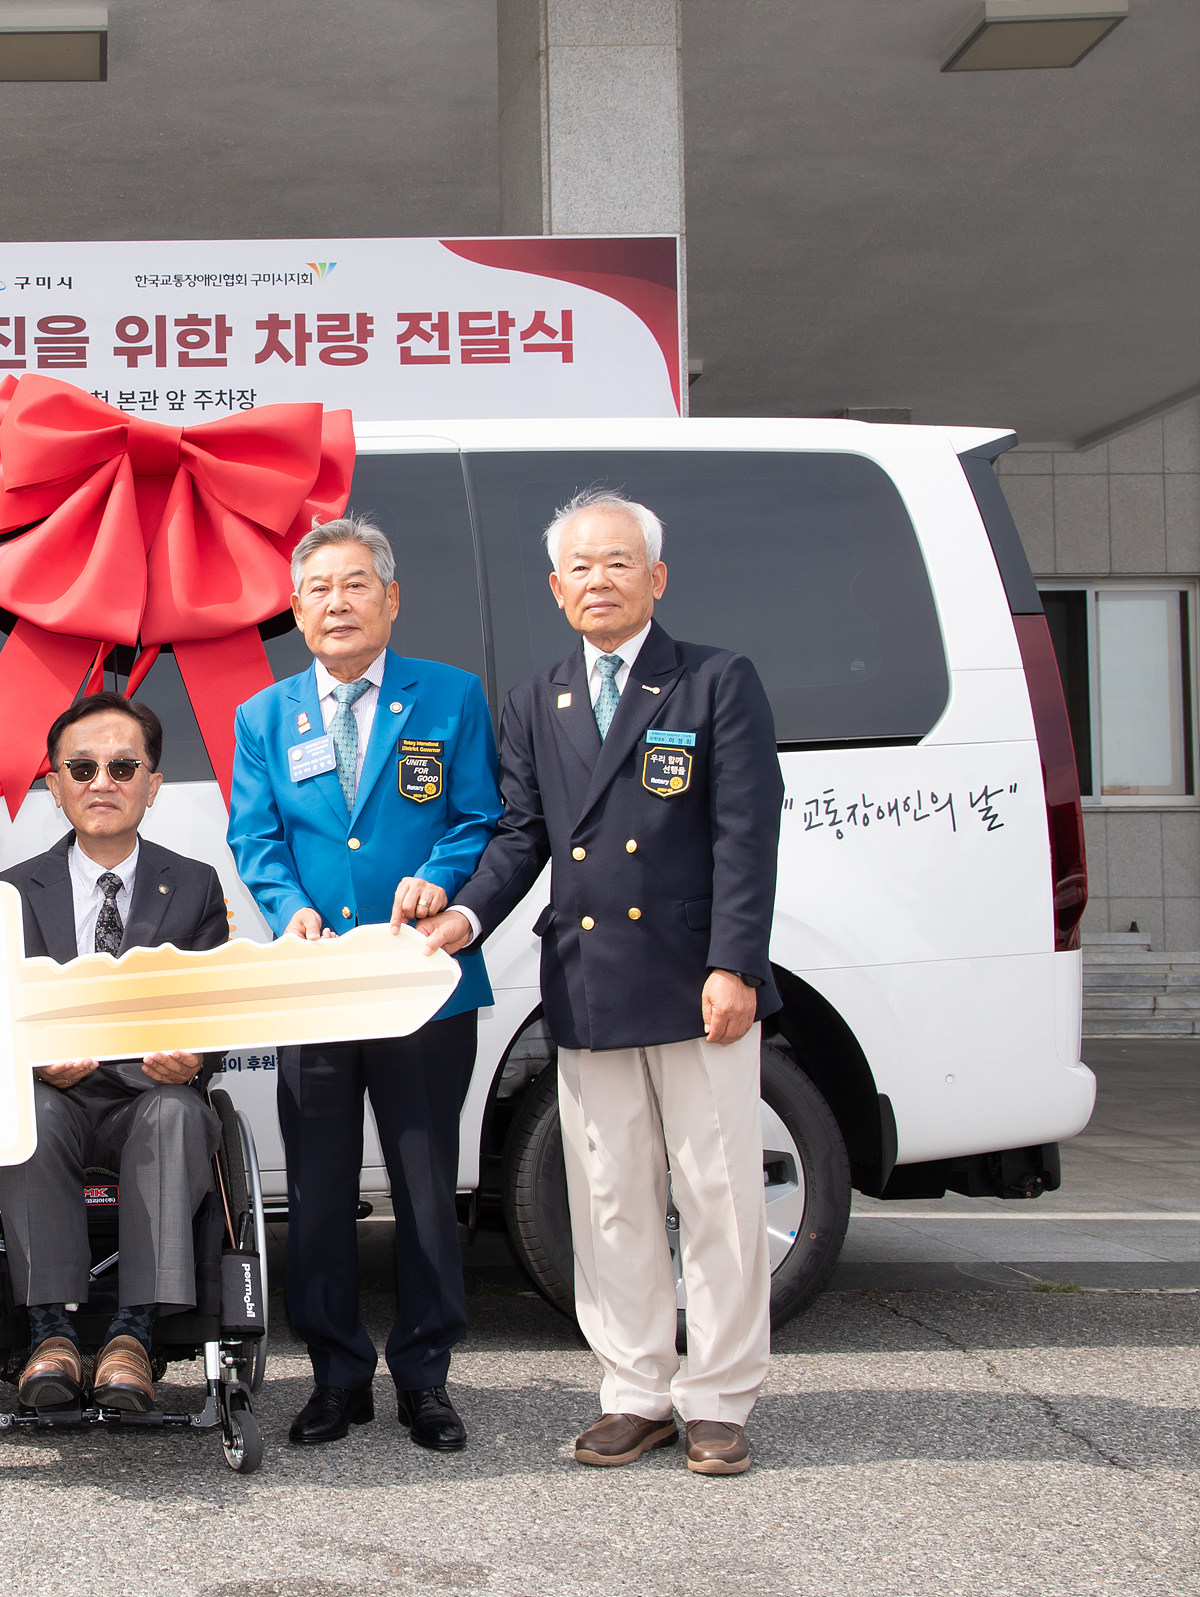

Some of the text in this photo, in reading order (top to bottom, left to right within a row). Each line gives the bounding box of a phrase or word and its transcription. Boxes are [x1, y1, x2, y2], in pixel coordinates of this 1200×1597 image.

[135, 273, 313, 288] 한국교통장애인협회 구미시지회
[113, 313, 233, 369] 위한
[254, 312, 375, 367] 차량
[396, 309, 574, 366] 전달식
[117, 390, 159, 411] 본관
[166, 389, 187, 411] 앞
[193, 389, 257, 411] 주차장
[650, 754, 666, 764] 우리
[651, 777, 670, 785] Rotary
[247, 1054, 278, 1072] 후원
[241, 1263, 256, 1318] permobil
